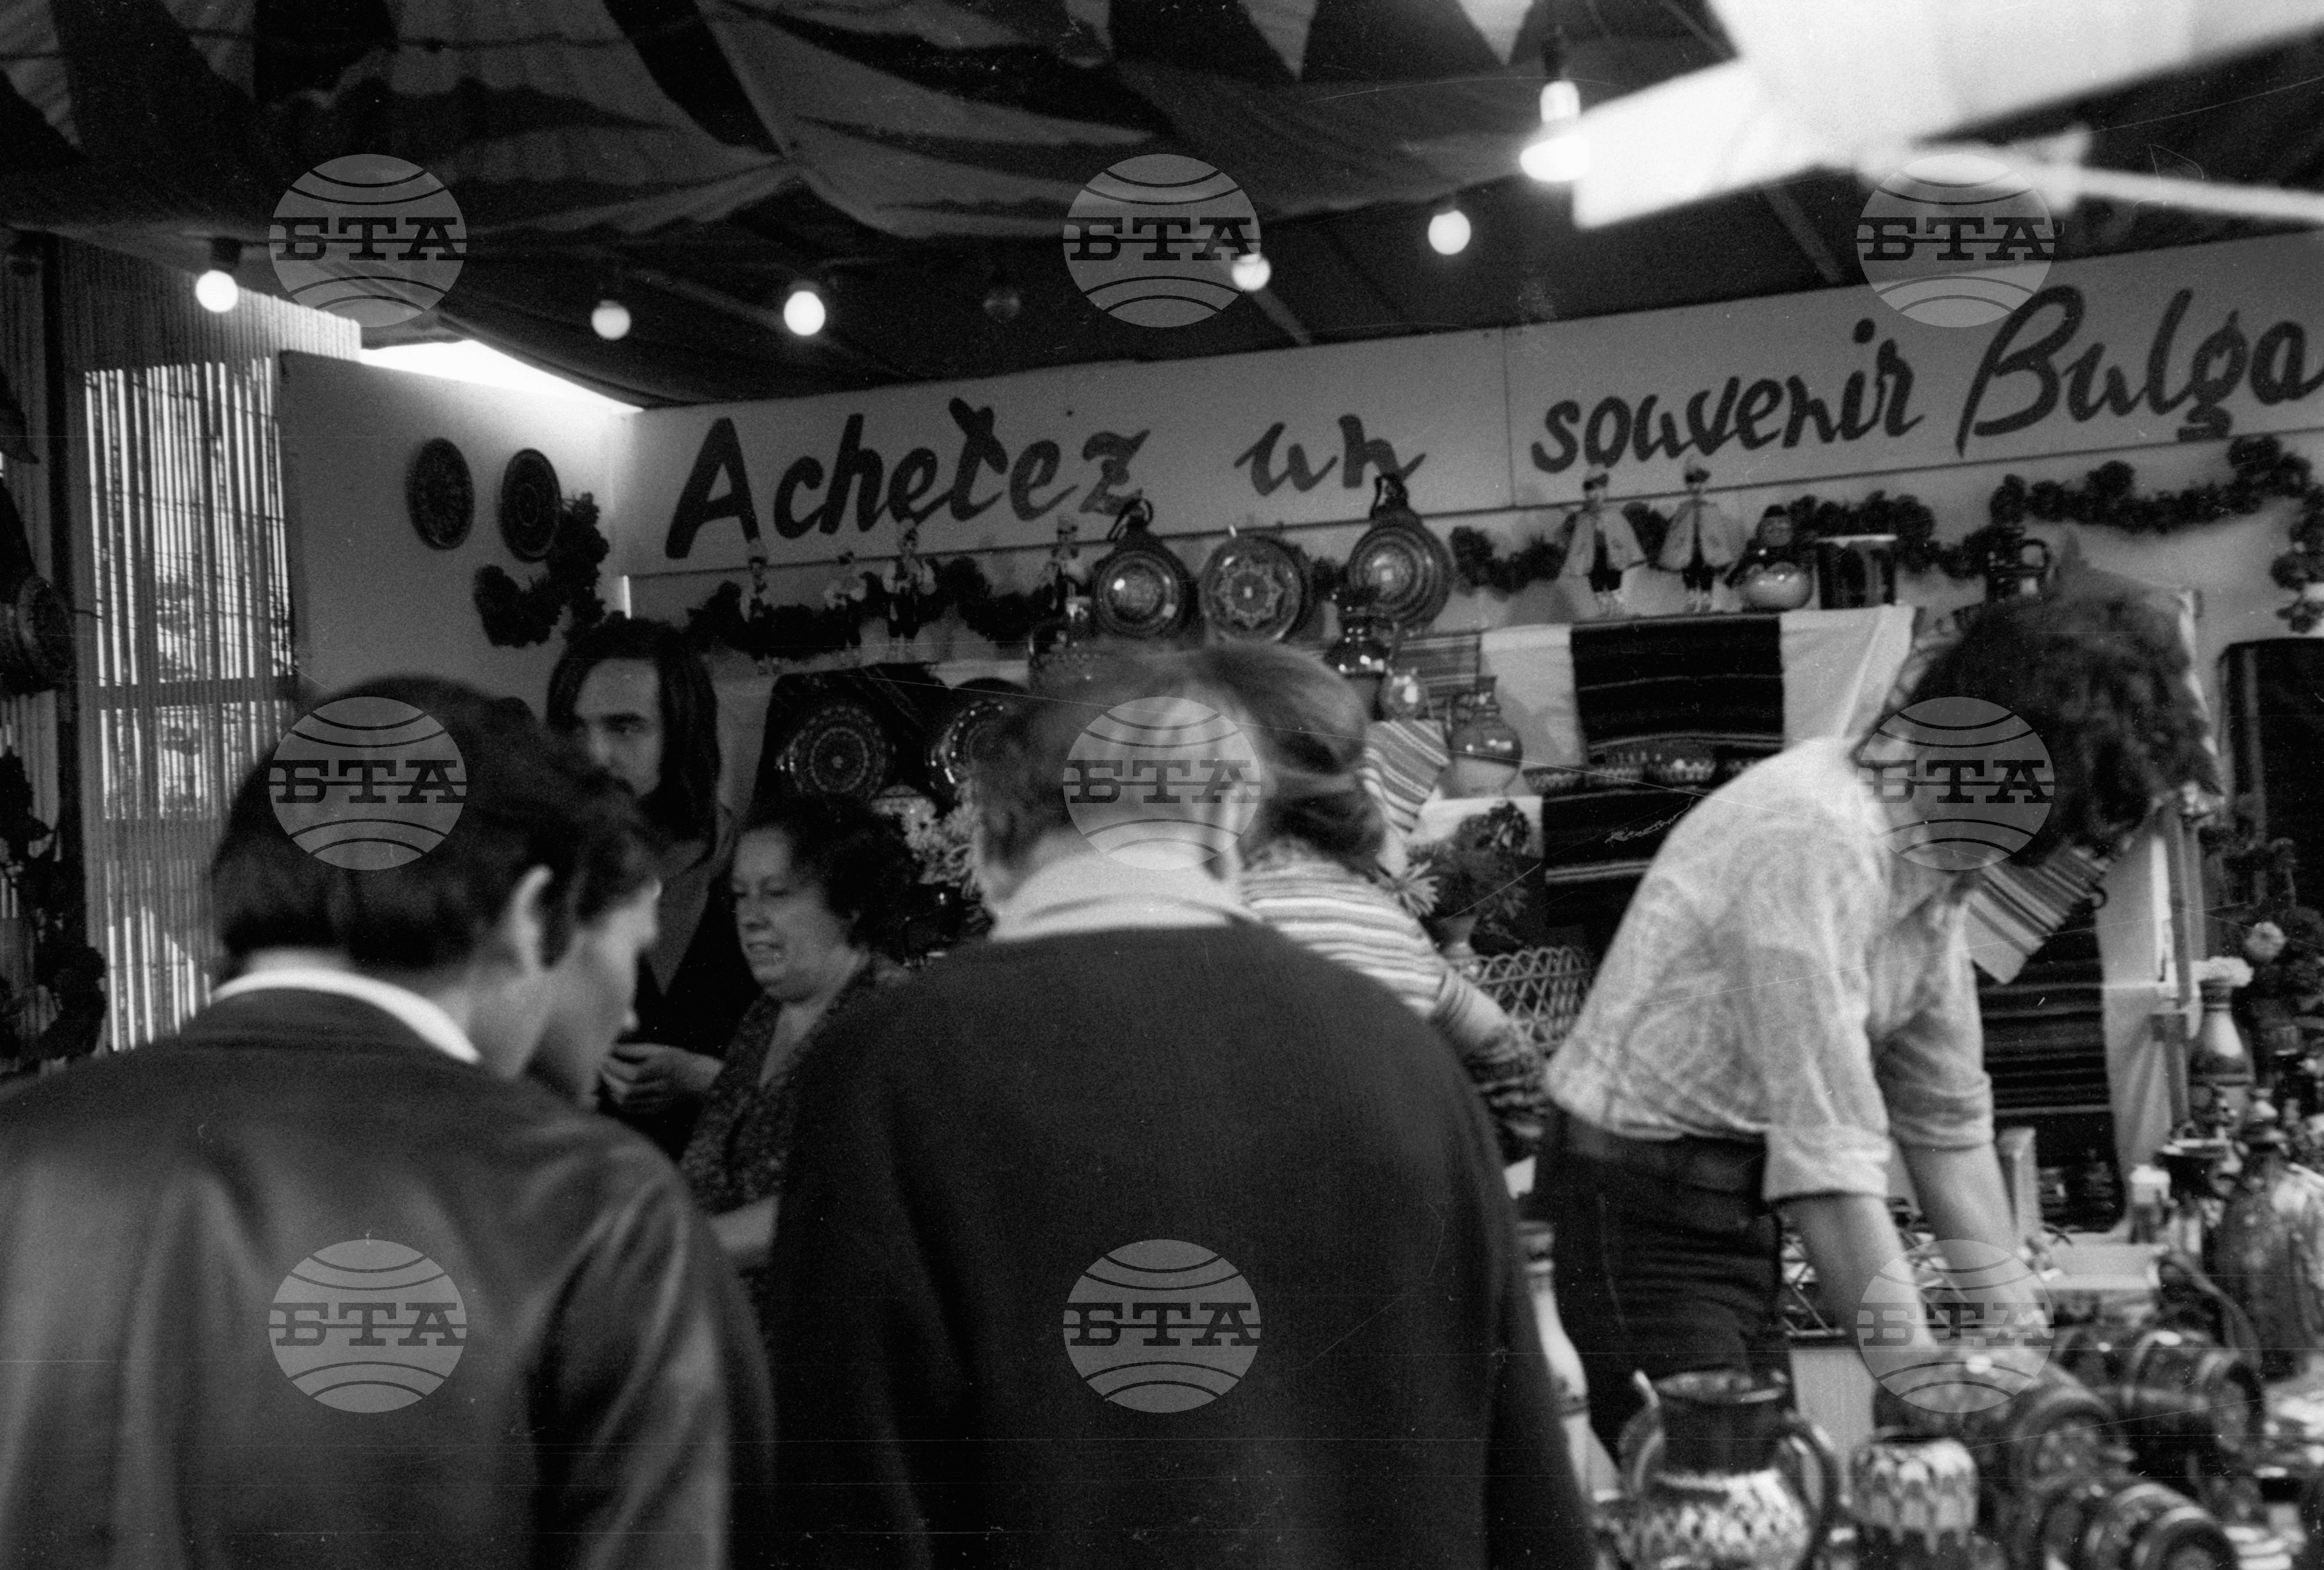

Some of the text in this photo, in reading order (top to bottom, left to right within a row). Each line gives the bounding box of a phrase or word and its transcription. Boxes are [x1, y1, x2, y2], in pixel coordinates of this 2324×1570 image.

[665, 397, 1150, 559] Achetez
[1234, 414, 1426, 496] un
[1530, 317, 1925, 473] souvenir
